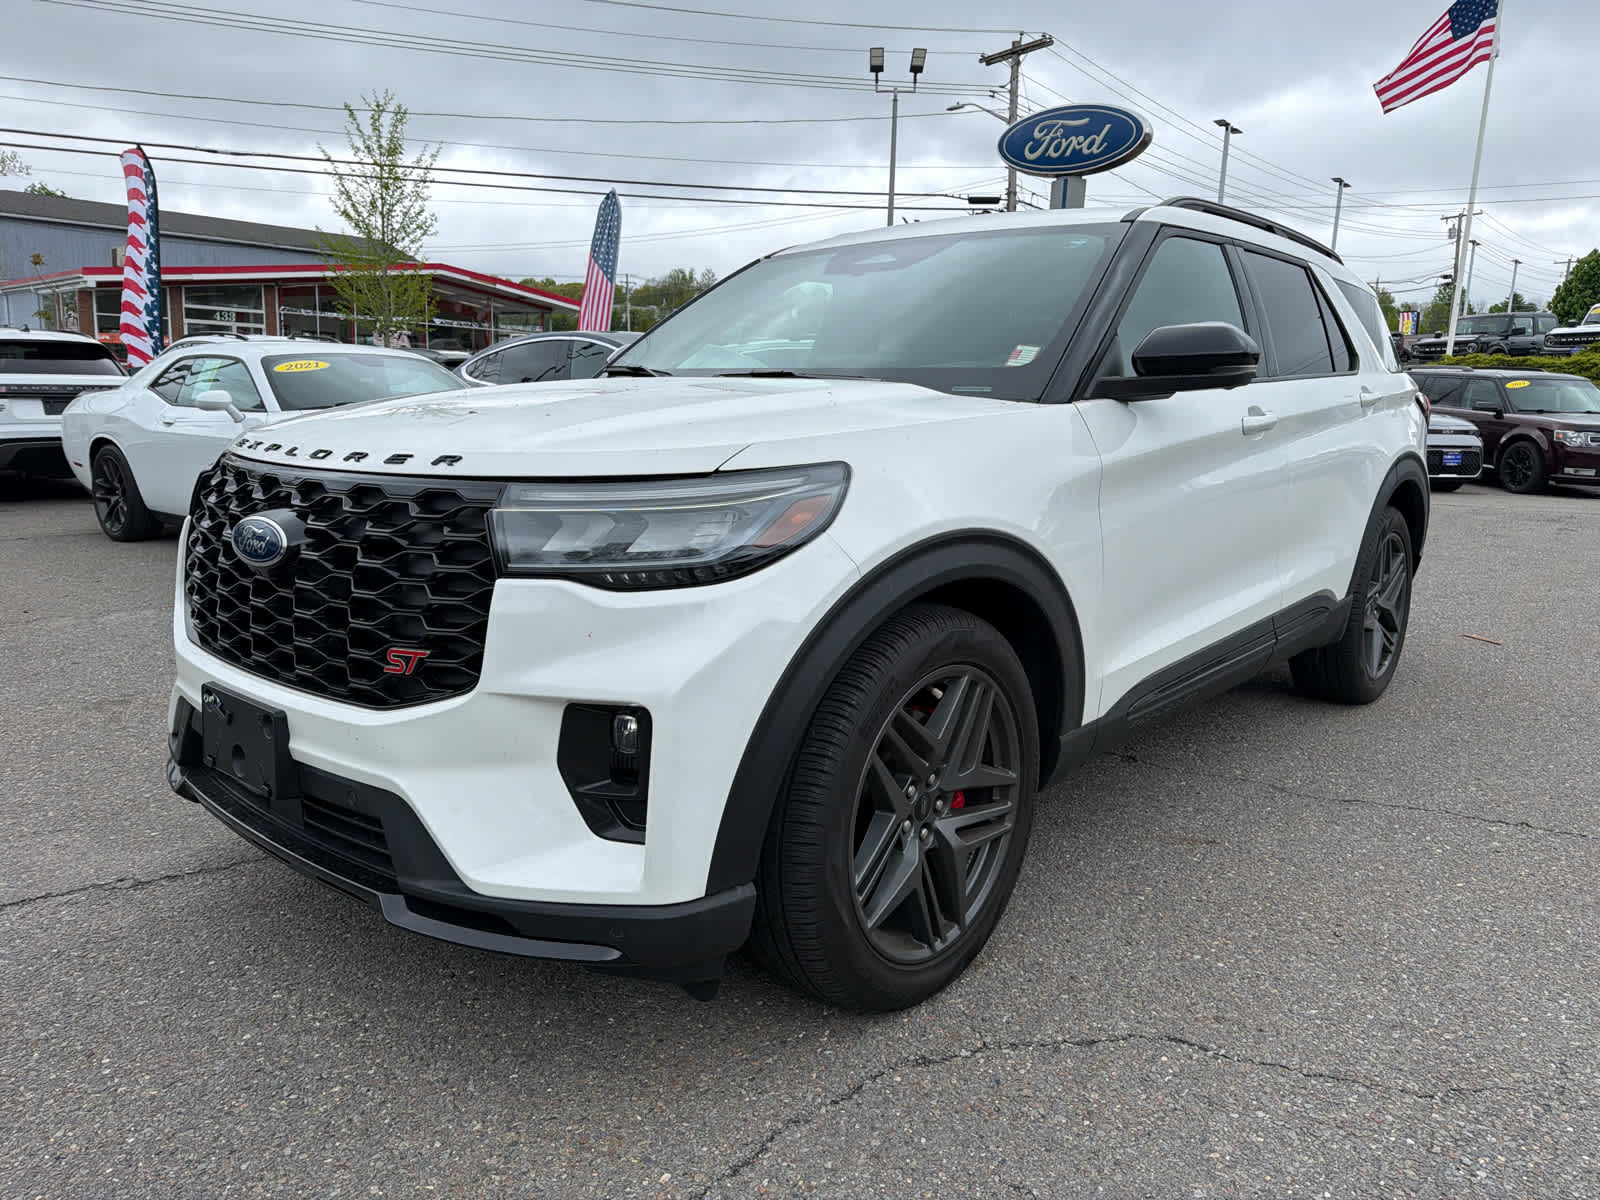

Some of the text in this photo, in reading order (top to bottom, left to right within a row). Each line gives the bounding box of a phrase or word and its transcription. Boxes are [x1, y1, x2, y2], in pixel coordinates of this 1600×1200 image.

[1024, 117, 1112, 161] Ford
[214, 311, 236, 321] 433
[284, 362, 319, 371] 2021
[235, 438, 463, 466] EXPLORER
[239, 525, 270, 552] Ford
[383, 647, 430, 675] ST
